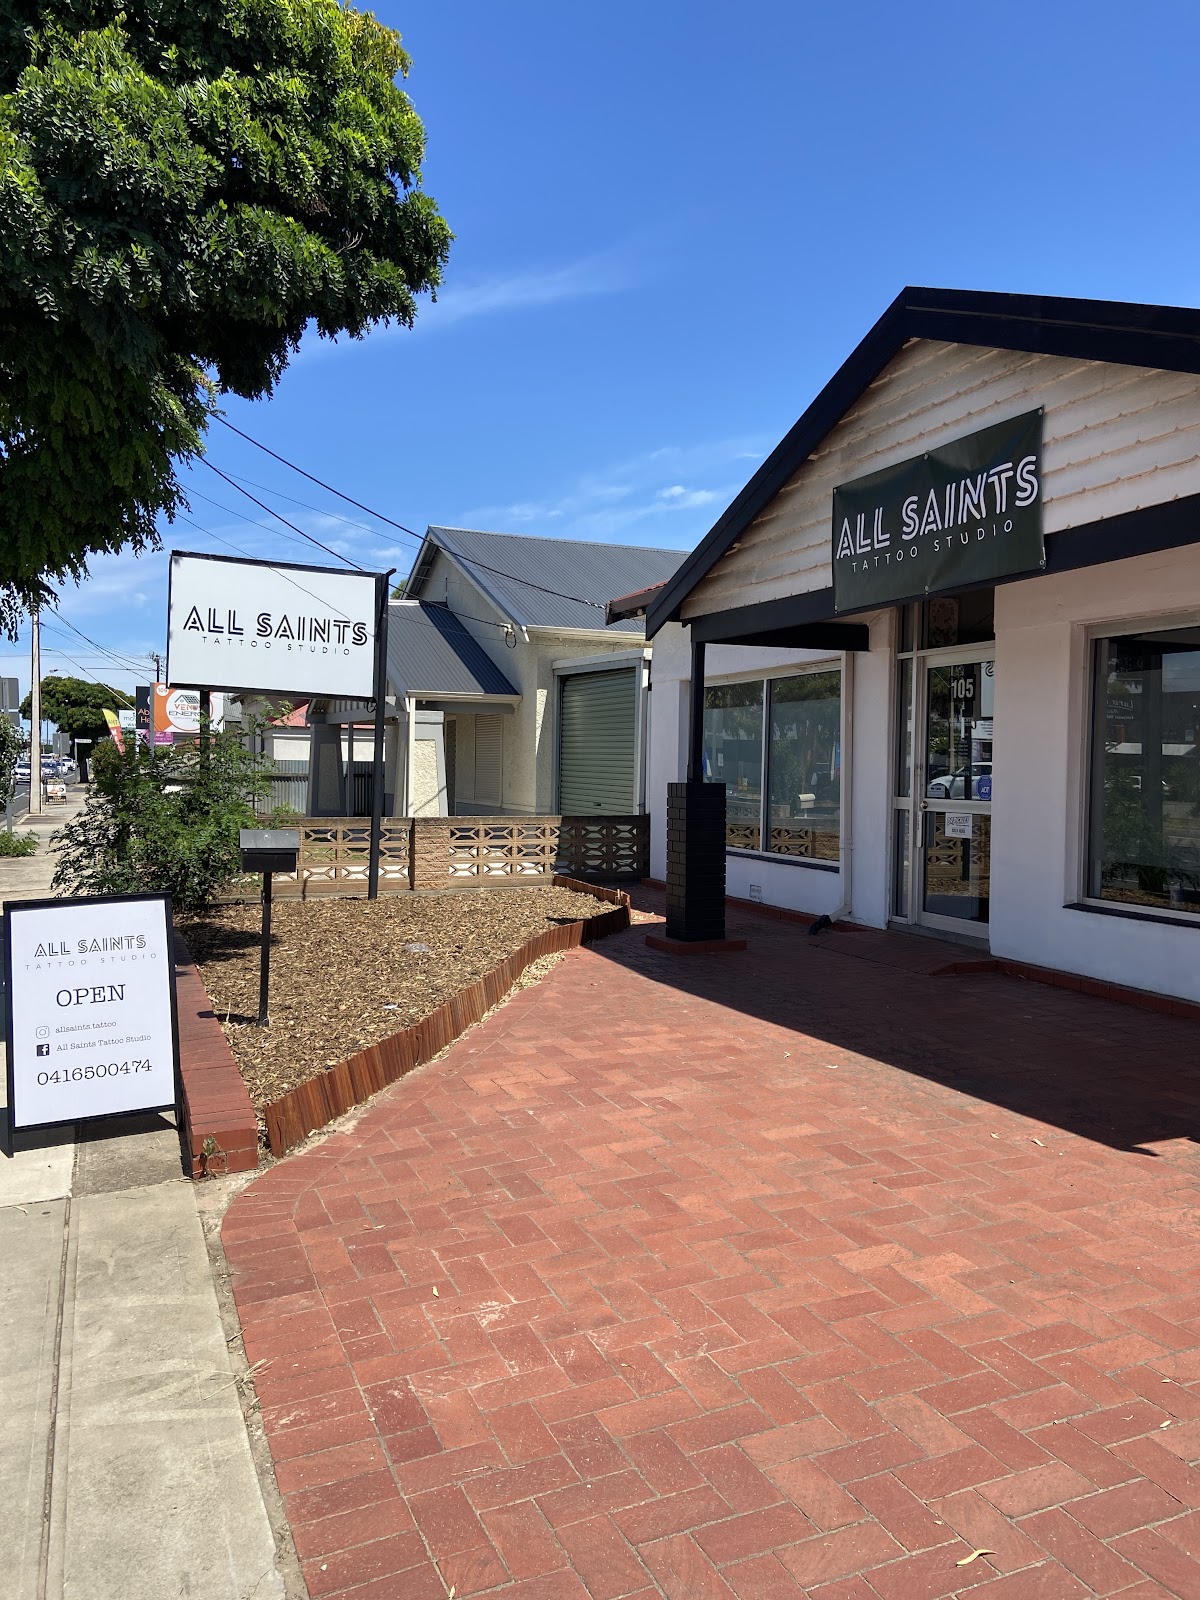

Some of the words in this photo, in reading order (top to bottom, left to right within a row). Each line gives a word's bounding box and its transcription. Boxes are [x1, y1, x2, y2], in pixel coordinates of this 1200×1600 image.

[836, 507, 890, 559] ALL
[901, 455, 1038, 541] SAINTS
[852, 546, 918, 572] TATTOO
[933, 519, 1013, 551] STUDIO
[182, 605, 244, 635] ALL
[256, 612, 367, 646] SAINTS
[202, 636, 272, 649] TATTOO
[287, 643, 350, 656] STUDIO
[952, 678, 974, 699] 105
[34, 942, 71, 958] ALL
[77, 934, 147, 955] SAINTS
[25, 960, 87, 971] TATTOO
[100, 952, 157, 964] STUDIO
[56, 984, 126, 1007] OPEN
[55, 1020, 117, 1034] allsaints.tattoo
[56, 1042, 69, 1052] All
[70, 1039, 97, 1050] Saints
[97, 1037, 125, 1047] Tattoo
[125, 1033, 152, 1043] Studio
[37, 1058, 153, 1086] 0416500474
